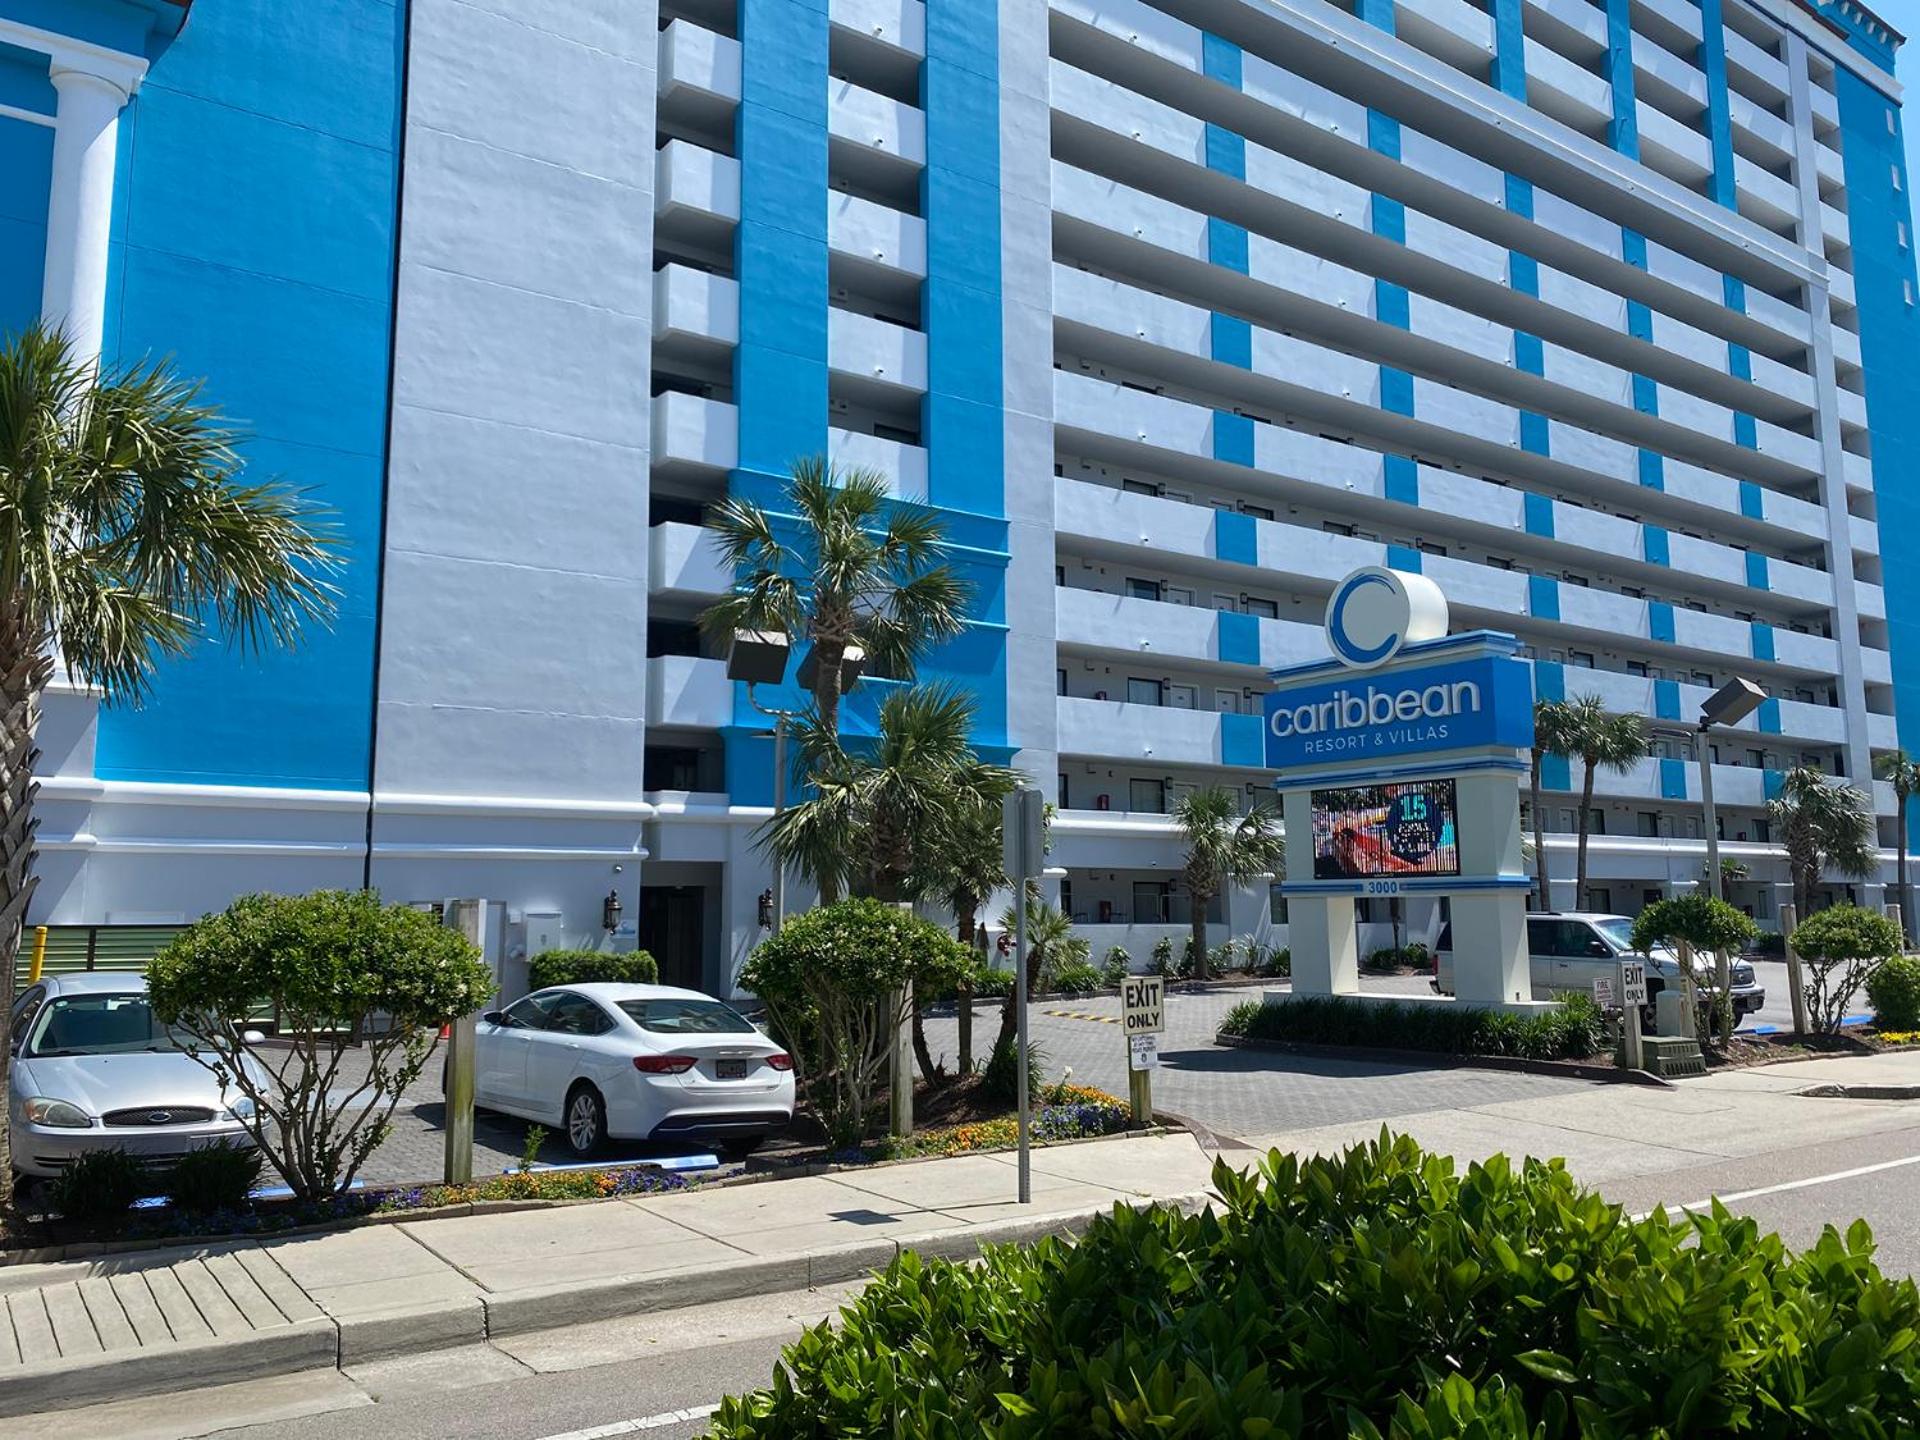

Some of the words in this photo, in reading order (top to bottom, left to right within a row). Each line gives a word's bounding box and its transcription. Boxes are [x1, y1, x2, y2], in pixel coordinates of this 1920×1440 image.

[1271, 680, 1480, 737] caribbean
[1305, 734, 1367, 753] RESORT
[1374, 733, 1383, 745] &
[1389, 725, 1449, 744] VILLAS
[1368, 881, 1398, 894] 3000
[1625, 967, 1643, 985] EXIT
[1126, 984, 1159, 1008] EXIT
[1626, 990, 1645, 1001] ONLY
[1127, 1012, 1160, 1029] ONLY
